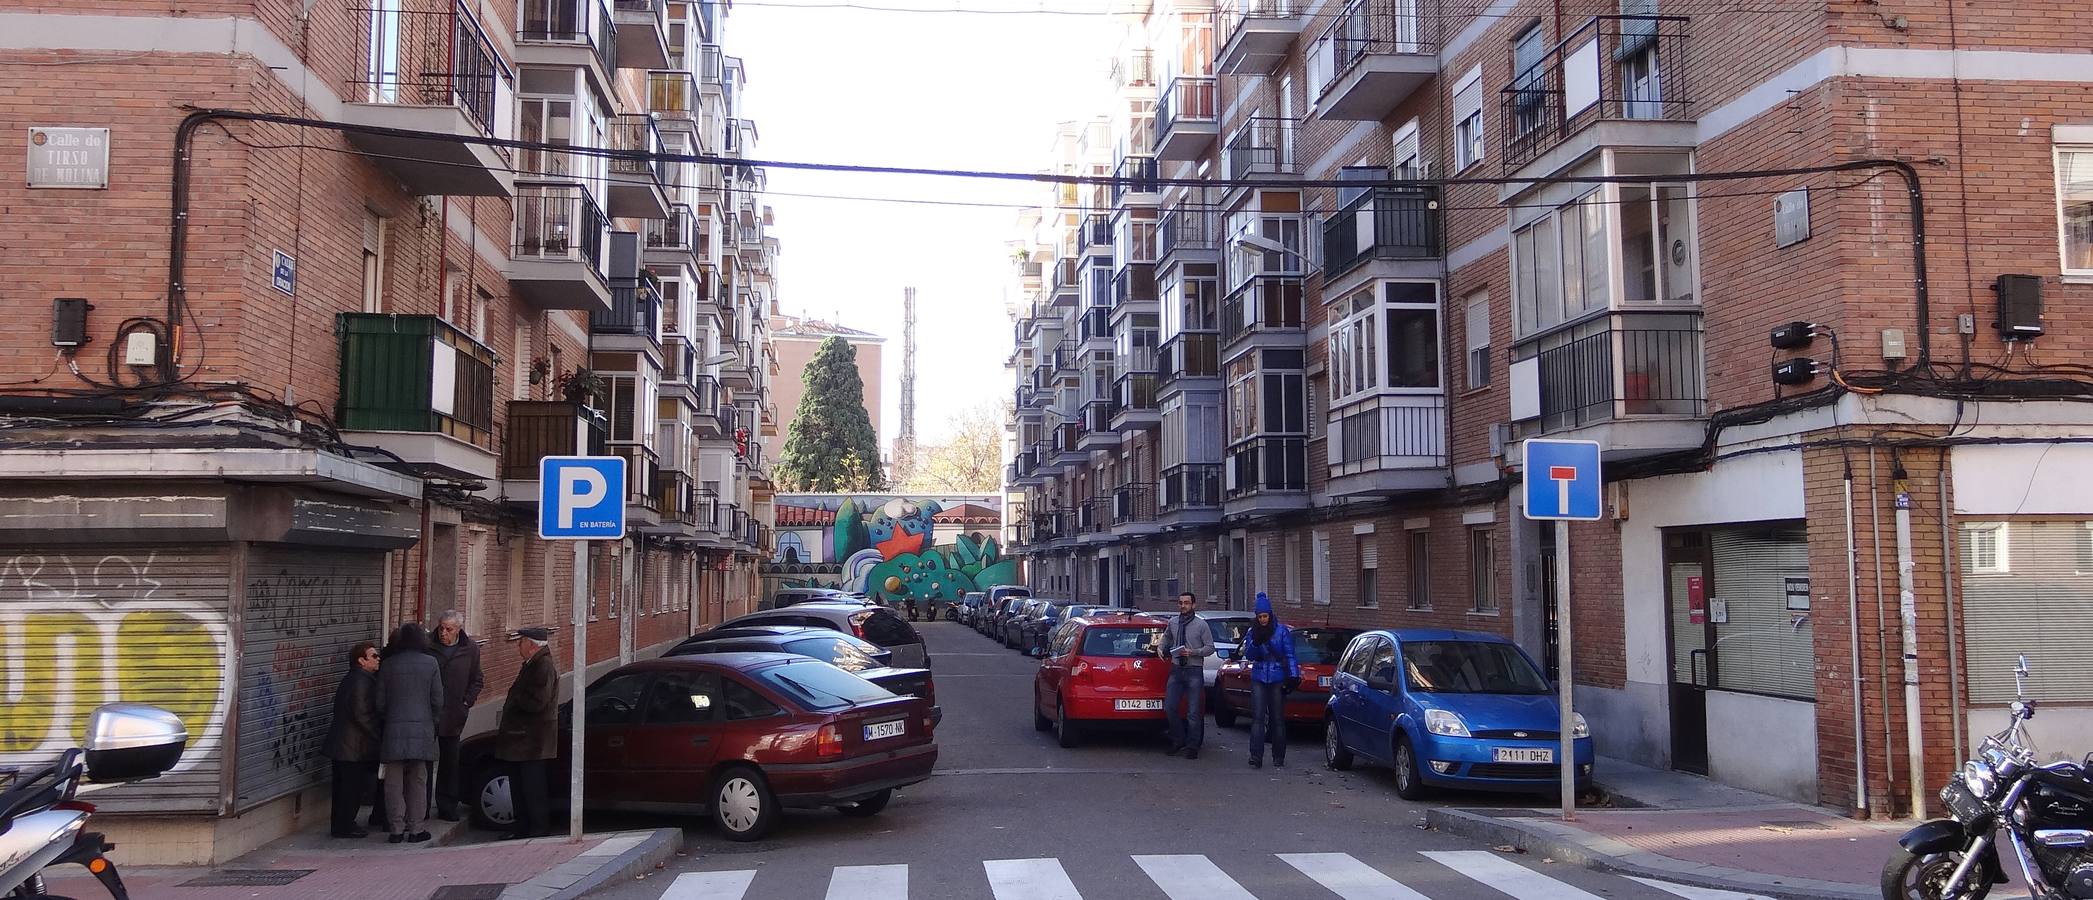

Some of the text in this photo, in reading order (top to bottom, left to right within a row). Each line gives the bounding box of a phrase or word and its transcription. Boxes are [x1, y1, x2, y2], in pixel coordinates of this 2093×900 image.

[48, 133, 80, 147] Calle
[47, 150, 88, 166] TIRSO
[34, 167, 100, 184] DE MOLINA
[558, 466, 608, 529] P
[580, 520, 616, 529] EN BATERÍA
[1121, 700, 1161, 709] 0142 BXT
[1501, 750, 1549, 762] 2111 DHZ
